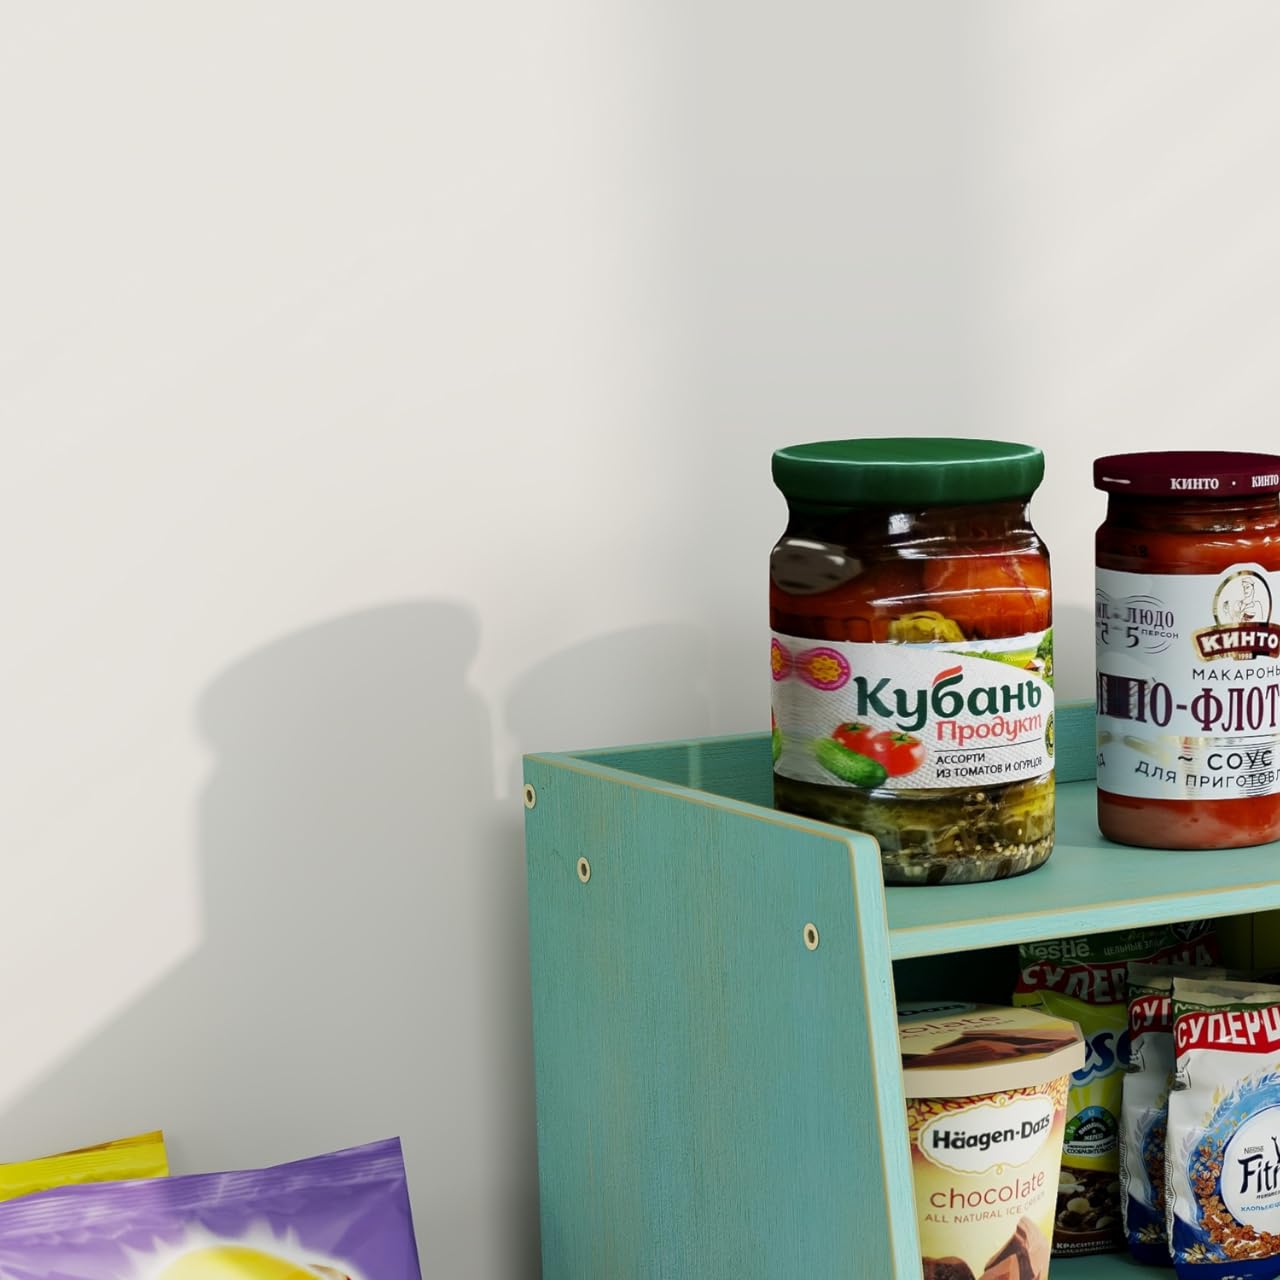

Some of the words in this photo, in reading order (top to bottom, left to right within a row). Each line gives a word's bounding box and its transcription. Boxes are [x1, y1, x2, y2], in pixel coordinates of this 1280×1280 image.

[1170, 477, 1219, 490] КИНТО
[1252, 474, 1280, 488] КИНТО
[1200, 631, 1280, 654] КИНТО
[853, 664, 1042, 733] Кубань
[935, 713, 1042, 746] Продукт
[935, 752, 986, 766] АССОРТИ
[1207, 750, 1273, 771] СОУС
[936, 768, 951, 779] ИЗ
[954, 764, 1003, 777] ТОМАТОВ
[1004, 762, 1012, 773] И
[1135, 760, 1177, 784] ДЛЯ
[932, 1113, 1051, 1151] Häagen-Dazs
[930, 1170, 1045, 1209] chocolate
[925, 1212, 949, 1223] ALL
[954, 1208, 1002, 1224] NATURAL
[1006, 1206, 1023, 1219] ICE
